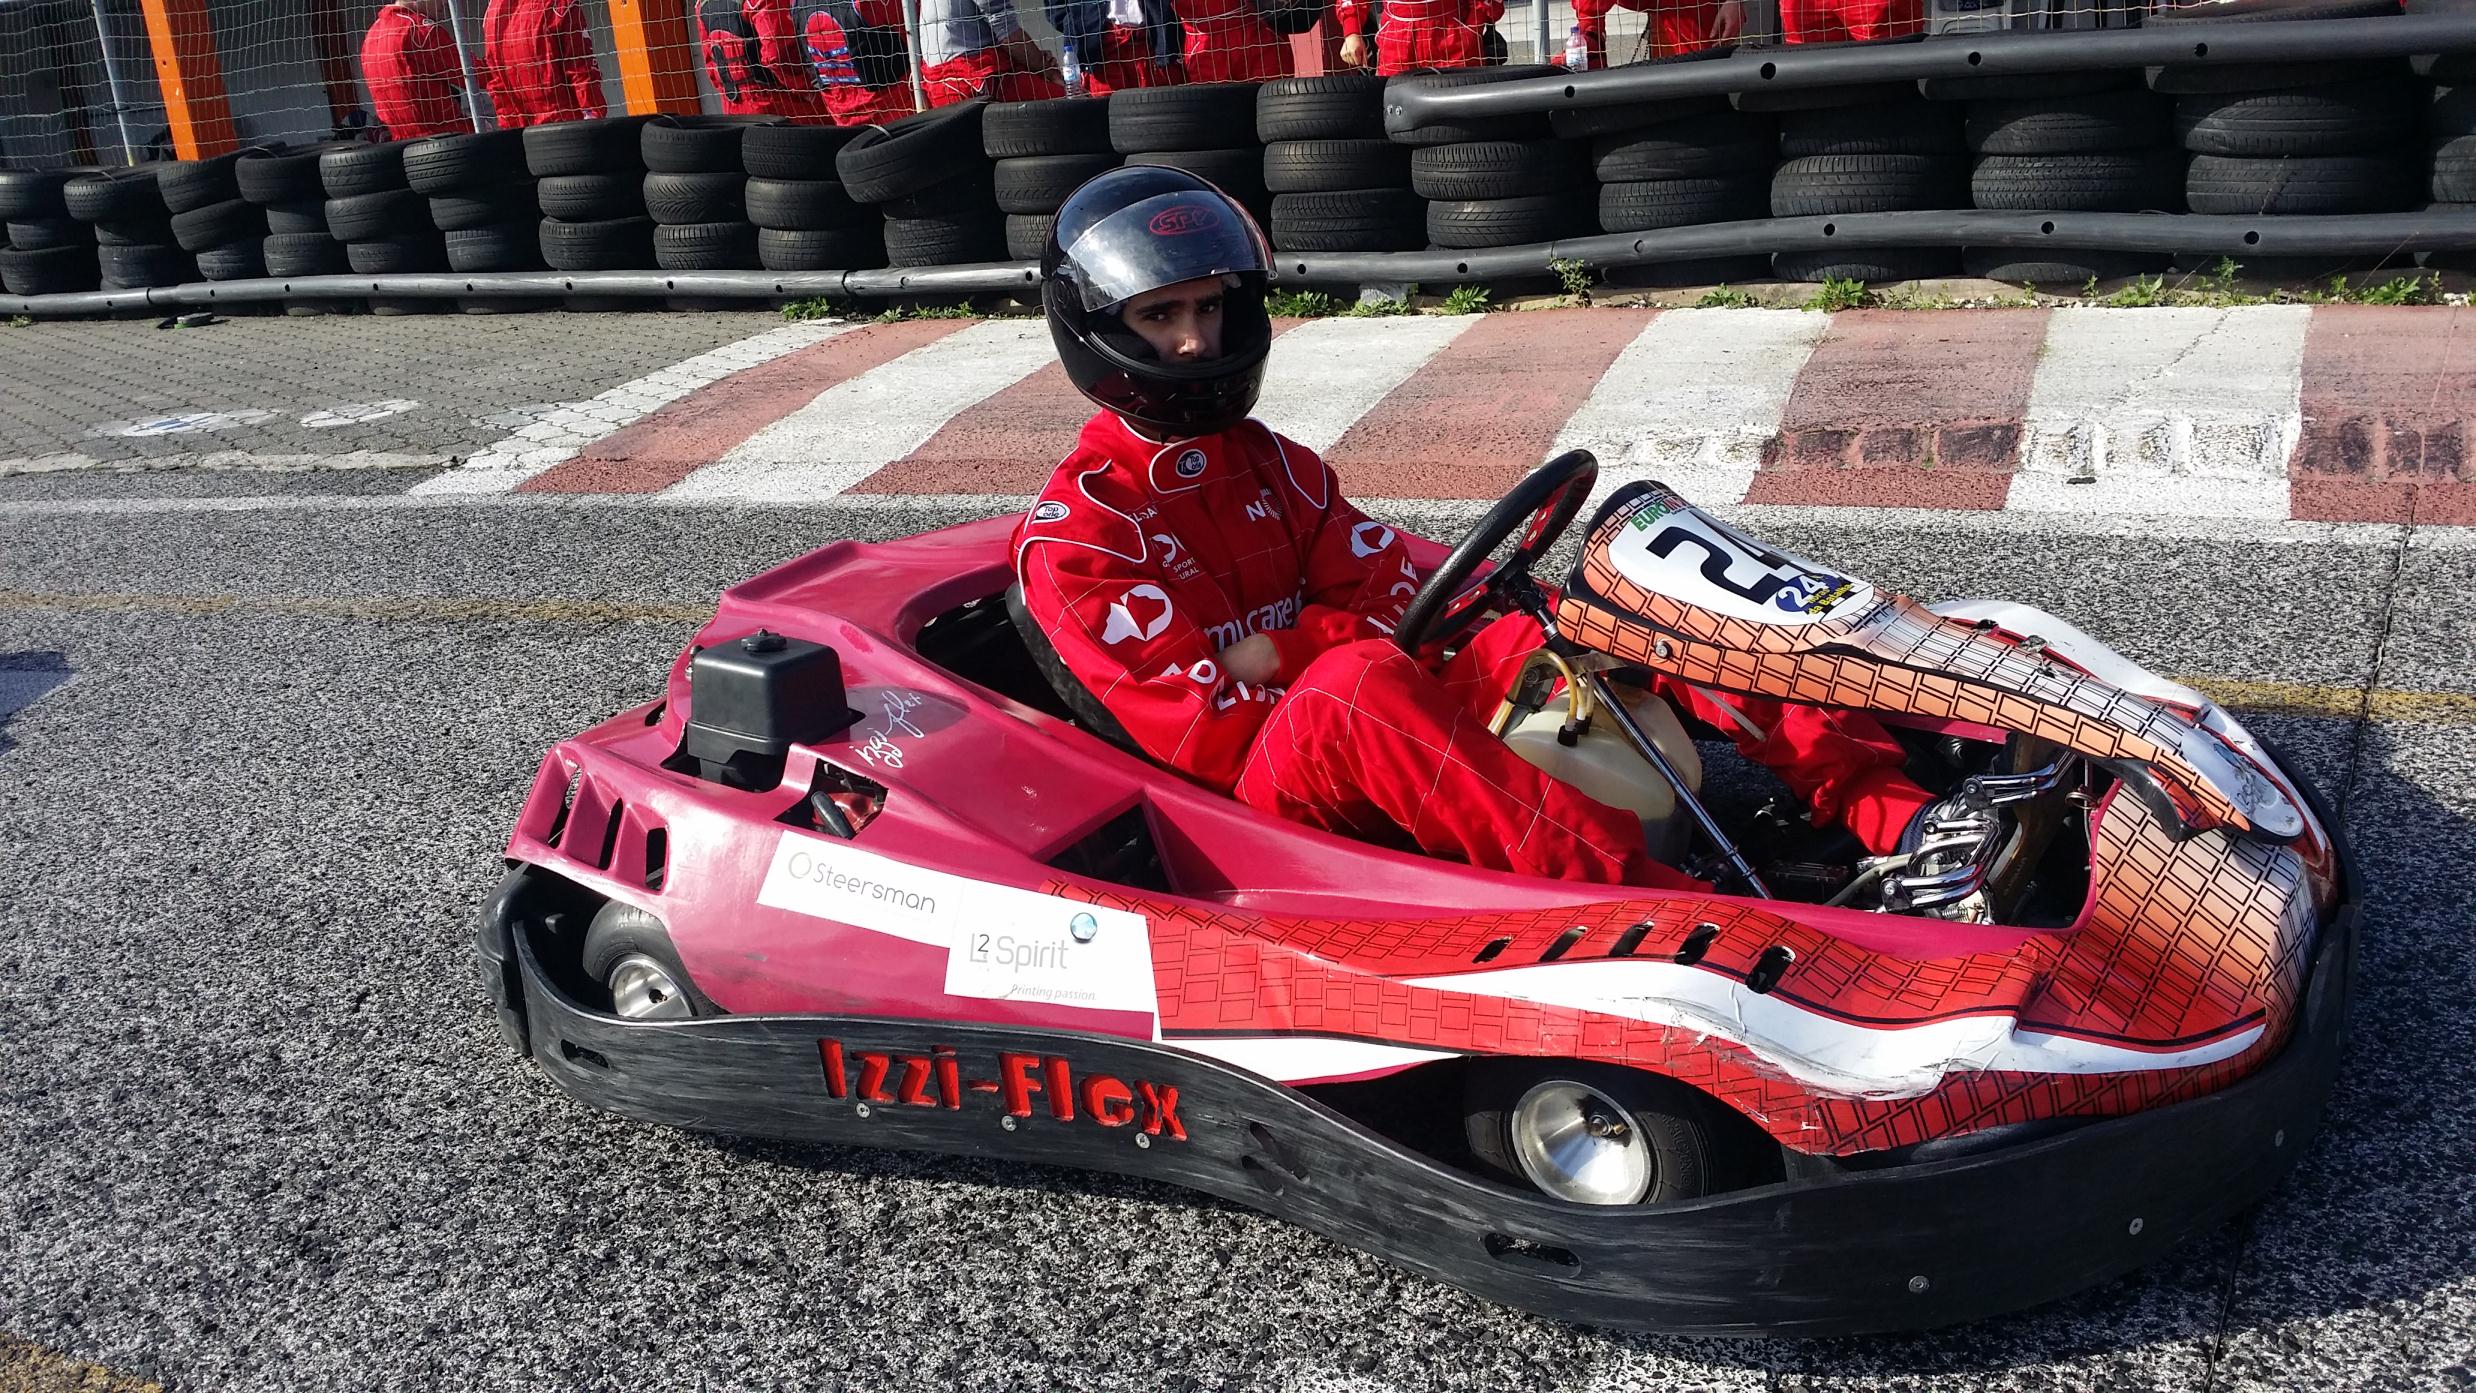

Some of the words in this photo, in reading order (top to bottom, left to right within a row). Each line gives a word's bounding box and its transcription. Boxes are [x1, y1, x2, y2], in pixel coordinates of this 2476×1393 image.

[1777, 574, 1830, 608] 24
[812, 862, 936, 914] Steersman
[995, 935, 1070, 973] Spirit
[1010, 983, 1054, 1001] Printing
